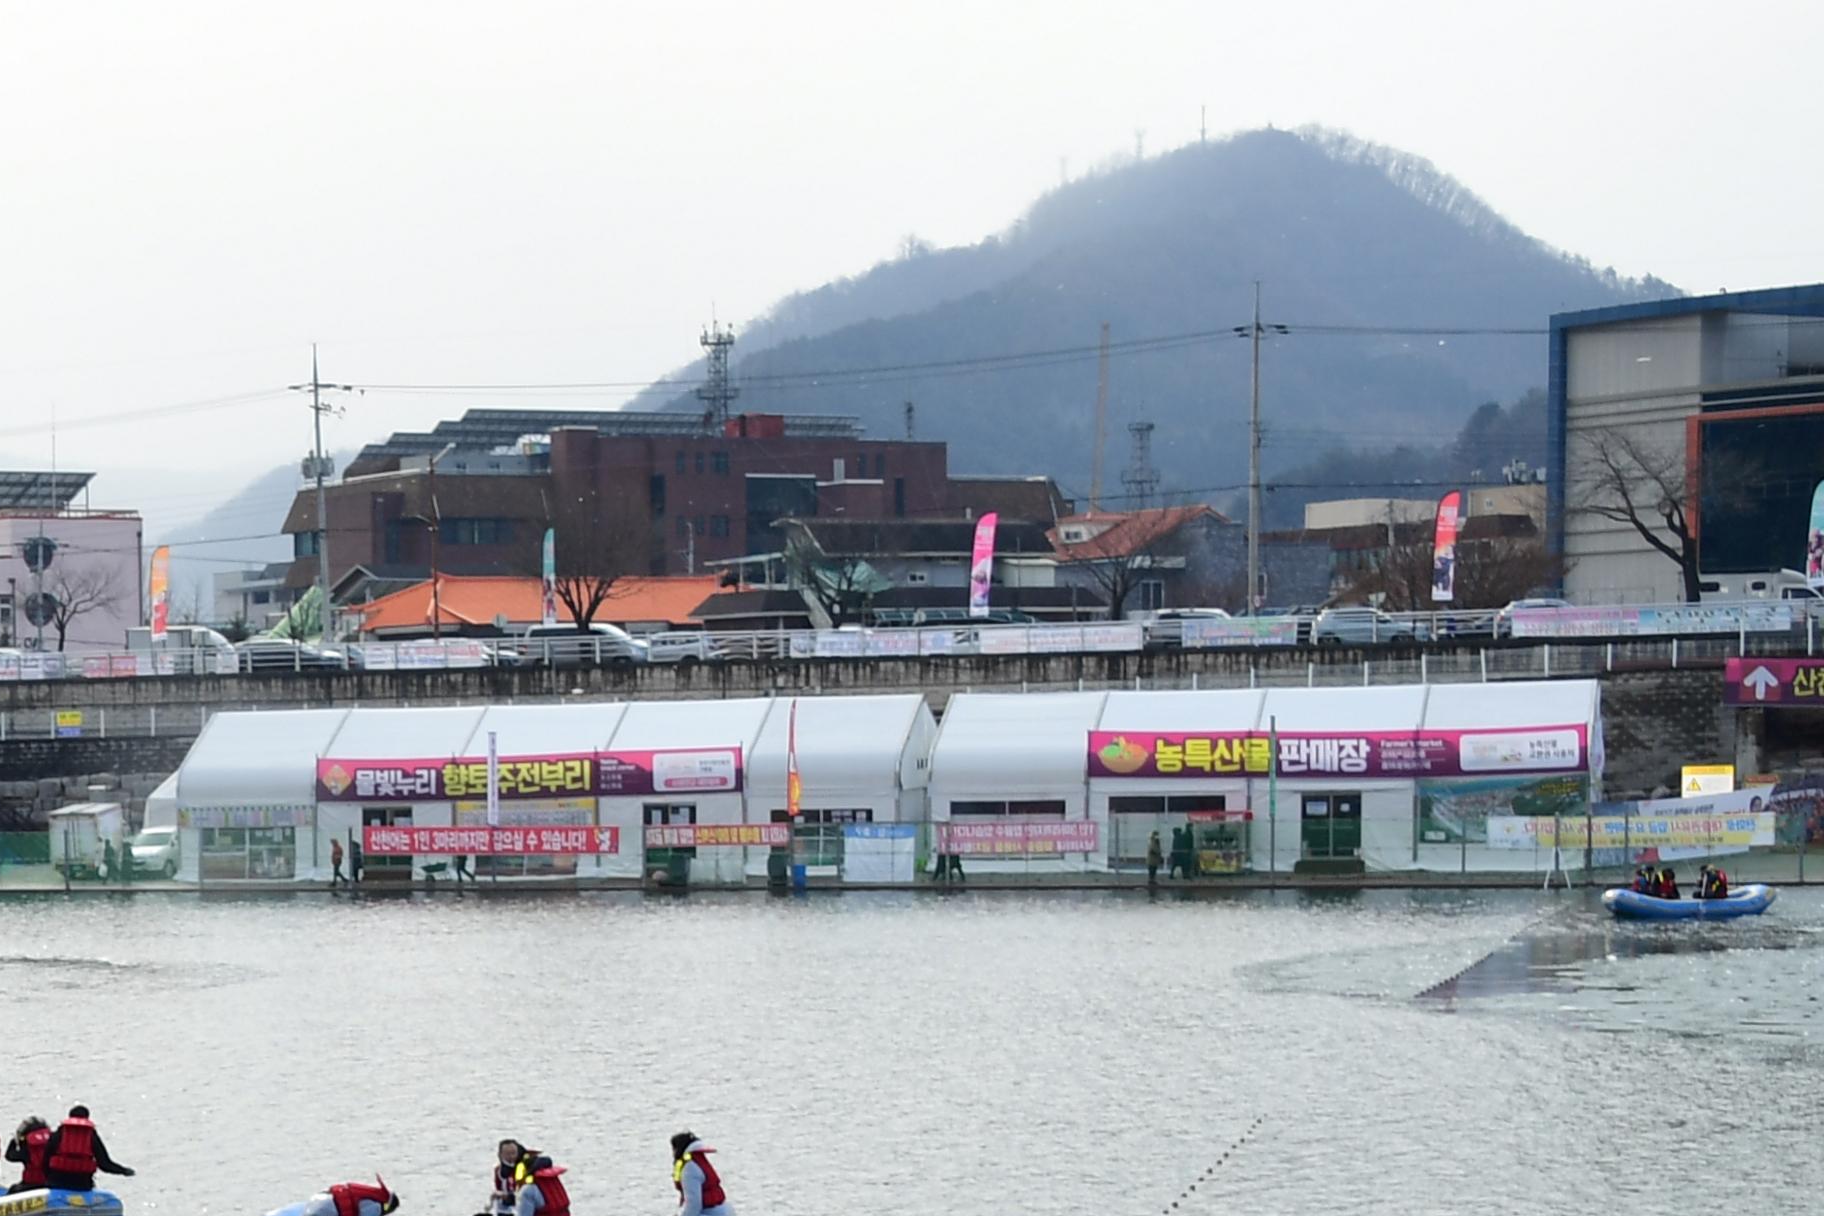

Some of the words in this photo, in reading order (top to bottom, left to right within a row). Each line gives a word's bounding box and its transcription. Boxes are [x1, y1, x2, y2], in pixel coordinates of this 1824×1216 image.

[1155, 737, 1271, 773] 농특산물
[1279, 738, 1370, 773] 판매장
[356, 769, 436, 797] 물빛누리
[371, 831, 412, 851] 산천어는
[413, 830, 430, 850] 1인
[432, 830, 489, 851] 3마리까지만
[492, 830, 524, 850] 잡으실
[527, 831, 538, 850] 수
[541, 829, 587, 850] 있습니다!
